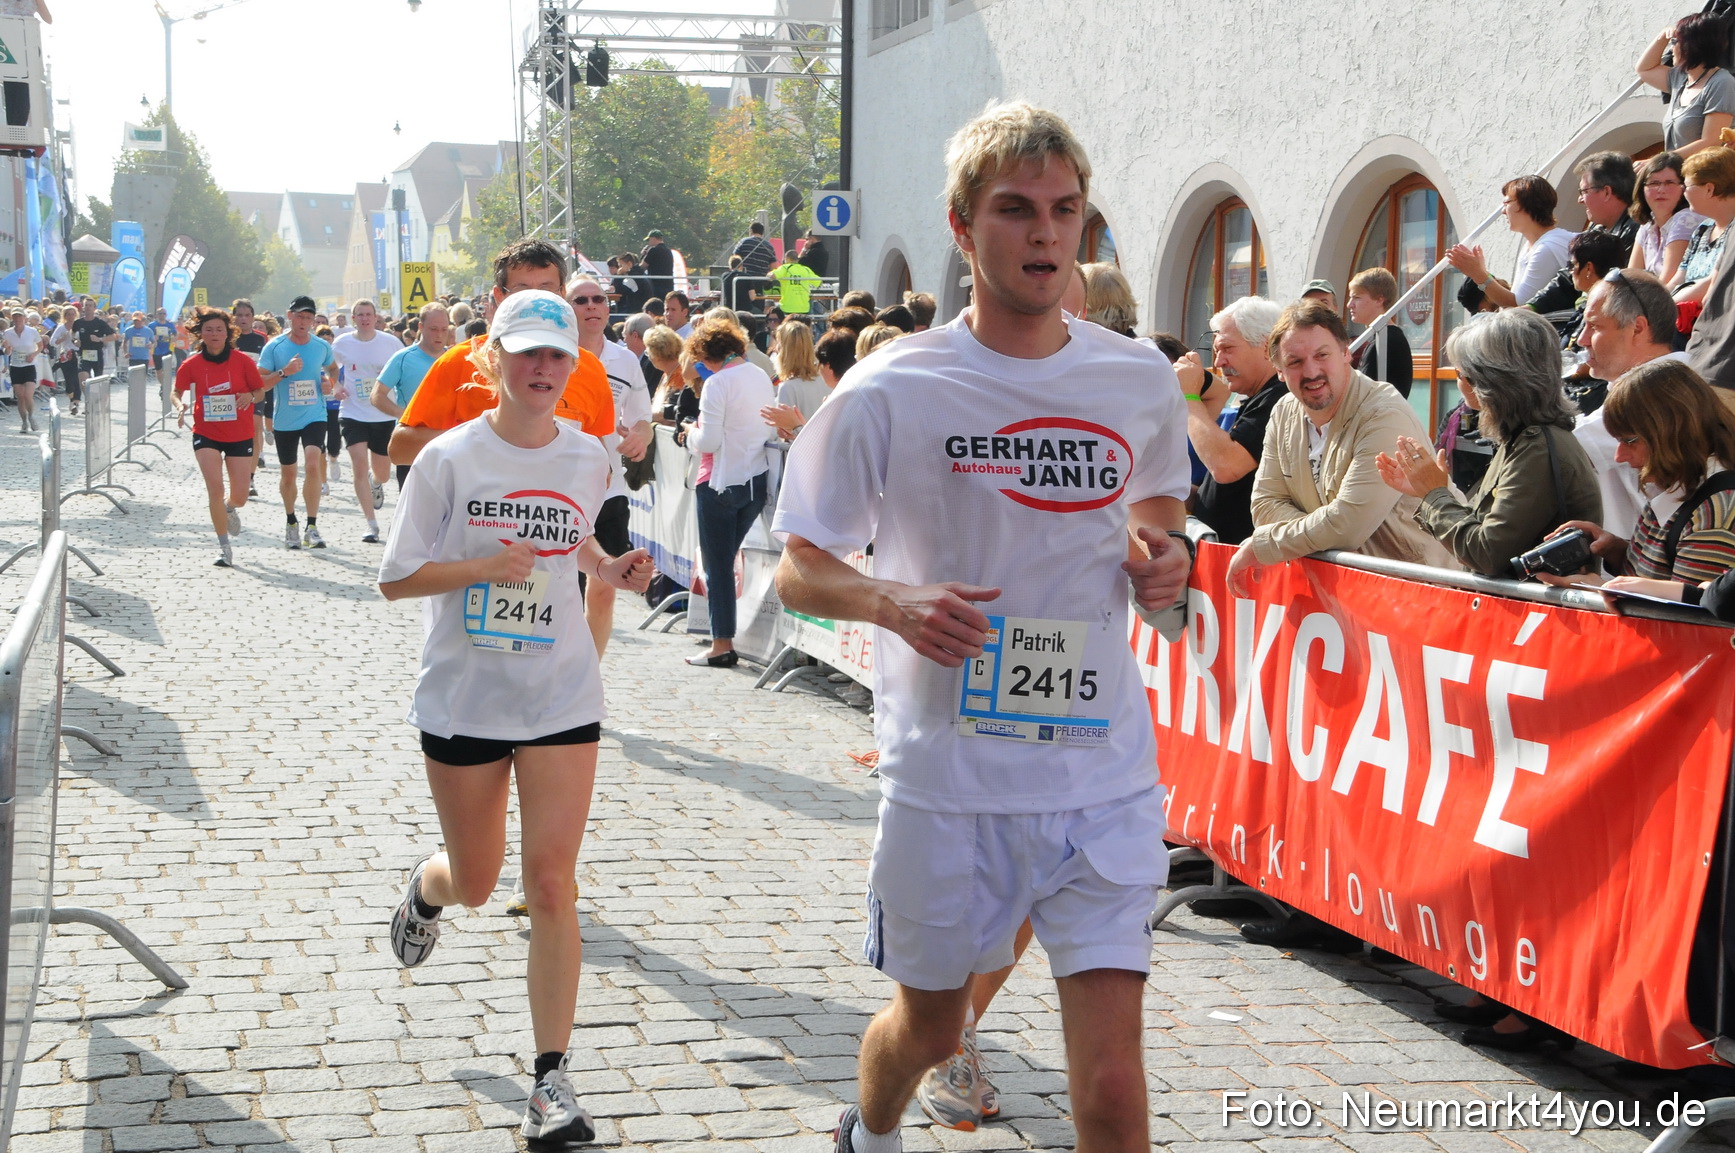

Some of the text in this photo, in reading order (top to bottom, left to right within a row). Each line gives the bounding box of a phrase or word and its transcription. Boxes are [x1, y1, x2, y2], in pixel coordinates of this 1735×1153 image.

[404, 263, 431, 273] Block
[409, 277, 428, 301] A
[298, 389, 315, 397] 3649
[212, 404, 233, 412] 2520
[945, 436, 1117, 462] GERHART &
[952, 462, 1118, 489] Autohaus JÄNIG
[467, 500, 580, 526] GERHART &
[468, 518, 579, 544] Autohaus JÄNIG
[471, 594, 477, 605] C
[494, 598, 553, 626] 2414
[1012, 628, 1066, 653] Patrik
[975, 660, 984, 676] C
[1009, 665, 1098, 701] 2415
[976, 722, 1017, 733] BOCK
[1056, 726, 1108, 738] PFLEIDERER
[1128, 588, 1549, 859] ARKCAFÉ
